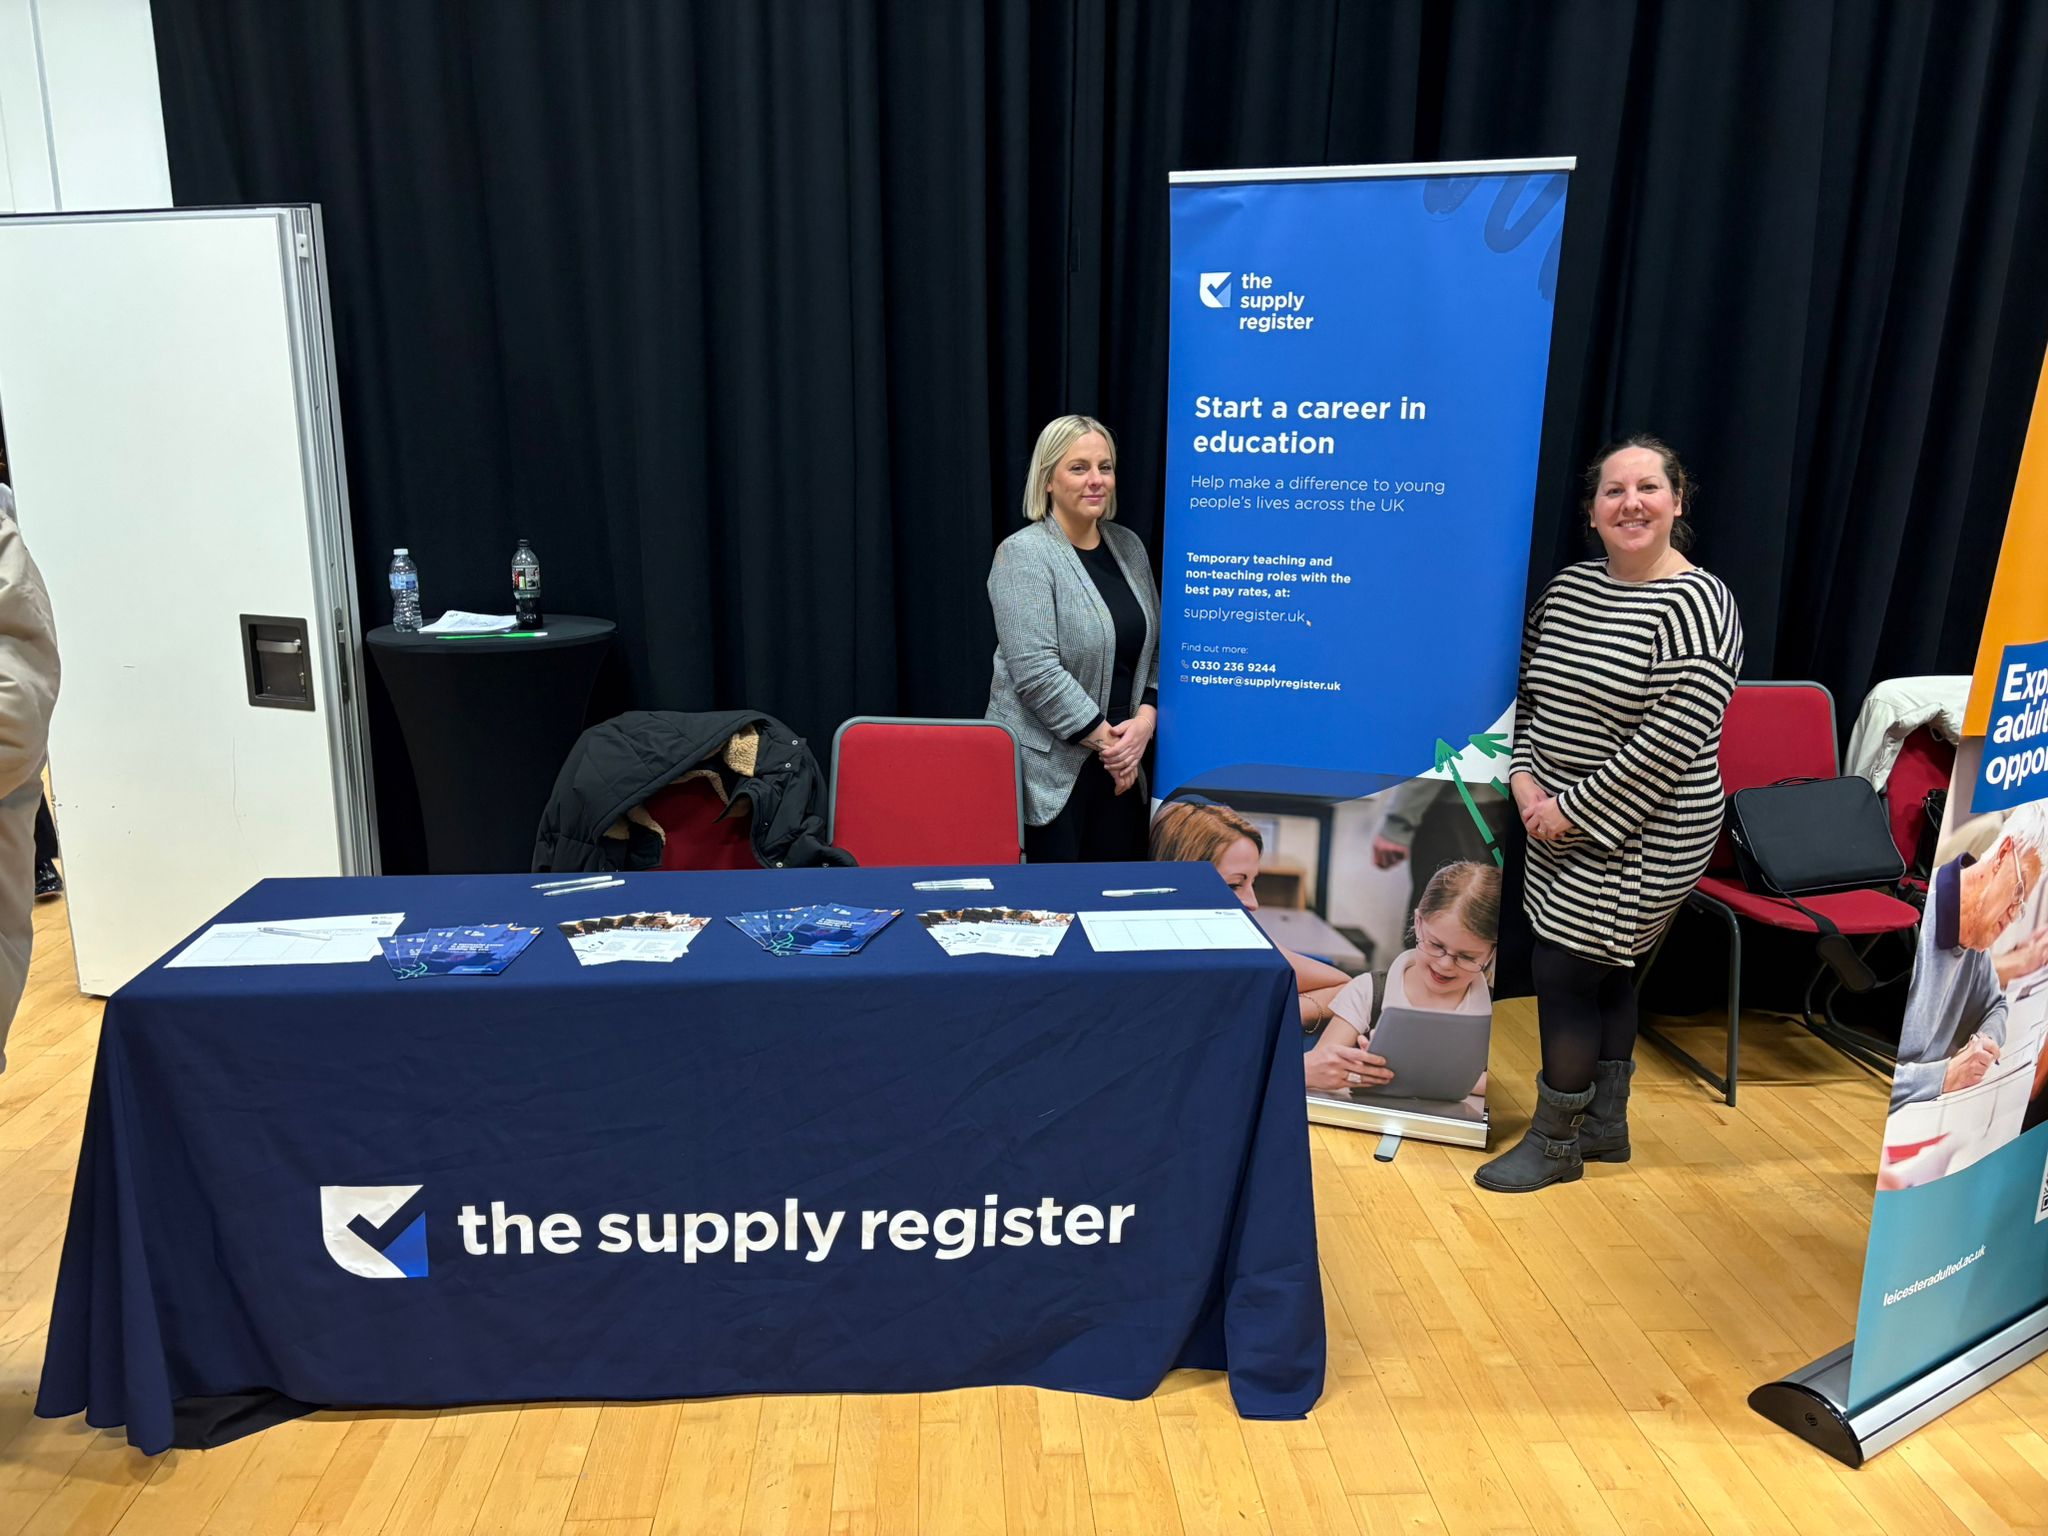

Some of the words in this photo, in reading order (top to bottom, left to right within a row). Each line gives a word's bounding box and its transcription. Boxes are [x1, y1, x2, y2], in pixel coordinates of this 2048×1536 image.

[1241, 272, 1272, 289] the
[1240, 291, 1304, 312] supply
[1239, 312, 1314, 333] register
[1195, 396, 1262, 418] Start
[1271, 402, 1288, 419] a
[1297, 401, 1390, 420] career
[1400, 396, 1426, 420] in
[1193, 430, 1335, 454] education
[1191, 475, 1224, 490] Help
[1229, 476, 1270, 489] make
[1275, 479, 1284, 489] a
[1289, 476, 1368, 491] difference
[1373, 478, 1389, 491] to
[1395, 481, 1445, 495] young
[1190, 495, 1251, 510] people's
[1256, 495, 1290, 510] lives
[1294, 499, 1345, 511] across
[1350, 497, 1376, 511] the
[1381, 499, 1405, 512] UK
[1187, 552, 1249, 565] Temporary
[1252, 554, 1306, 567] teaching
[1309, 556, 1332, 567] and
[1186, 569, 1263, 582] non-teaching
[1267, 571, 1297, 582] roles
[1301, 572, 1328, 583] with
[1331, 573, 1351, 584] the
[1185, 584, 1209, 596] best
[1212, 587, 1235, 598] pay
[1238, 587, 1271, 599] rates,
[1274, 588, 1291, 598] at:
[1184, 607, 1305, 623] supplyregister.uk
[1181, 643, 1201, 653] Find
[1203, 645, 1219, 654] out
[1221, 646, 1249, 655] more:
[1192, 660, 1221, 671] 0330
[1223, 661, 1245, 672] 236
[1248, 662, 1277, 673] 9244
[1191, 674, 1341, 691] register@supplyregister.uk
[2002, 663, 2048, 705] Exp
[457, 1200, 582, 1256] the
[597, 1198, 846, 1264] supply
[861, 1193, 1136, 1260] register
[1883, 1244, 1986, 1307] leicesteradulted.ac.uk
